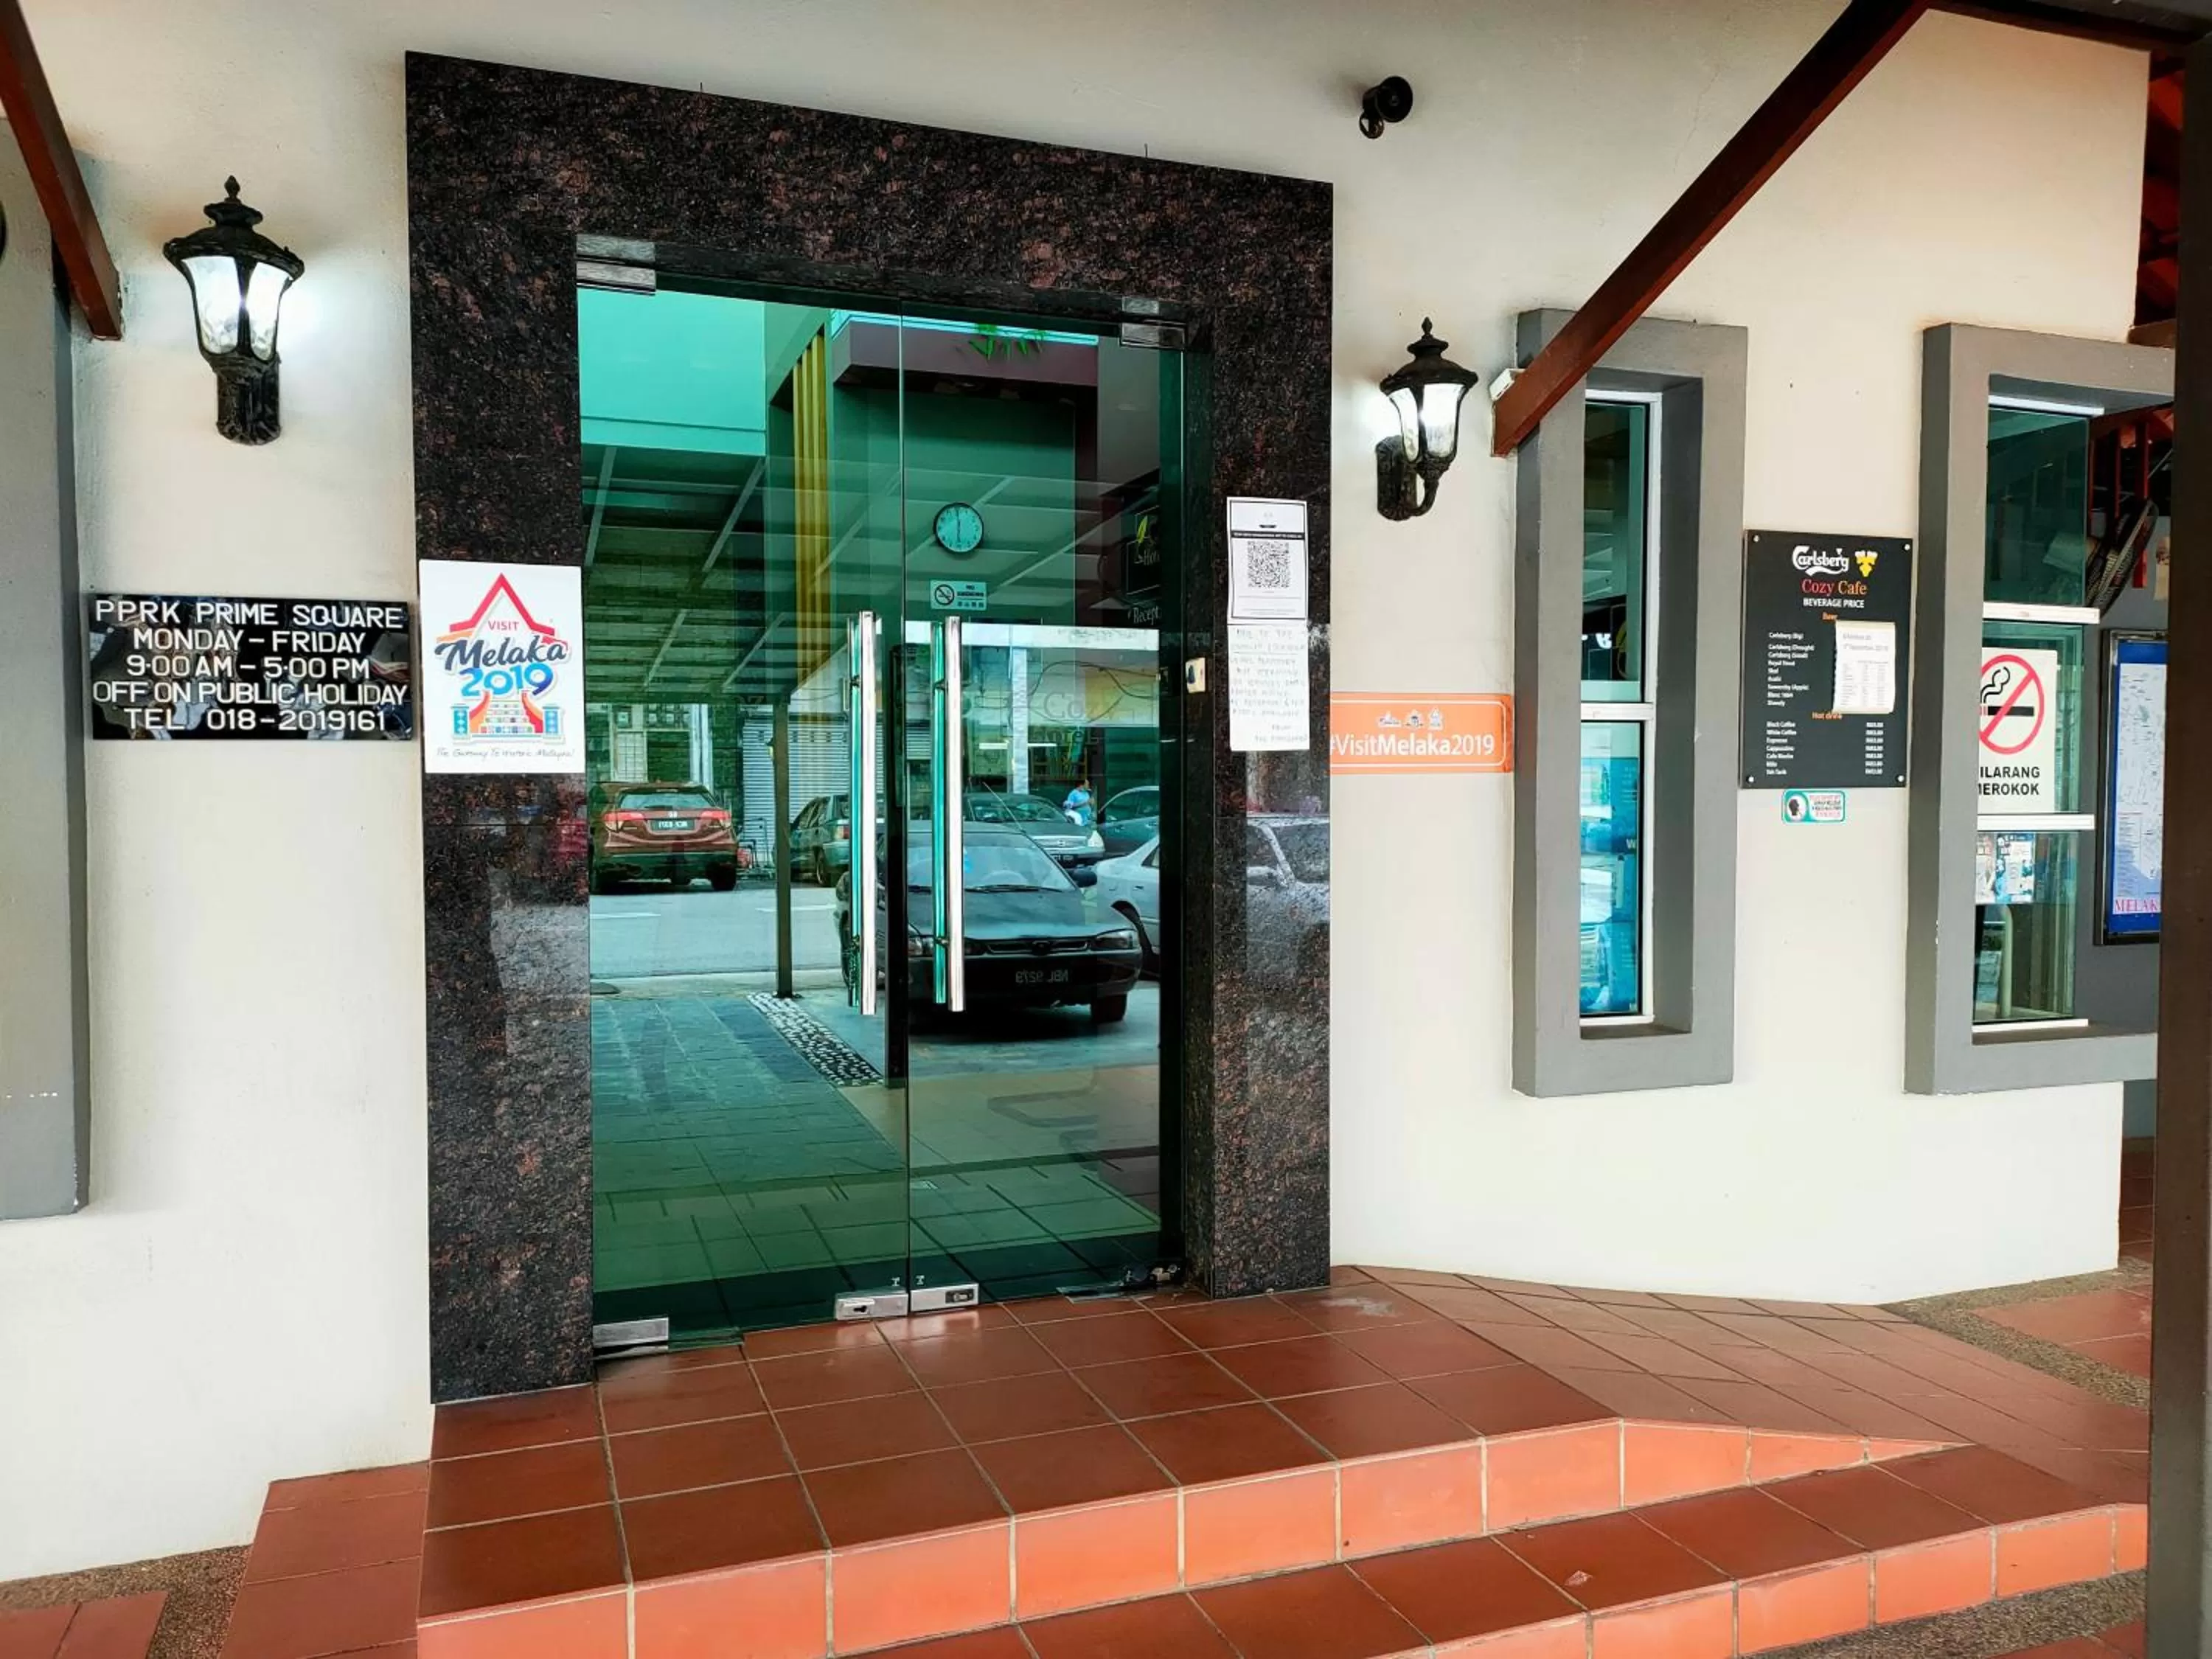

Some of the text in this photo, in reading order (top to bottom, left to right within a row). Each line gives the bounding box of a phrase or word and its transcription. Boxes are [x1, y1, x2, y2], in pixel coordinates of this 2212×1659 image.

[1792, 546, 1849, 574] Carlsberg
[1801, 579, 1867, 597] Cozy Cafe
[95, 600, 403, 629] PPRK PRIME SQUARE
[1803, 597, 1864, 608] BEVERAGE PRICE
[487, 620, 519, 630] VISIT
[133, 628, 244, 651] MONDAY
[272, 630, 366, 653] FRIDAY
[434, 635, 568, 671] Melaka
[195, 657, 233, 678] AM
[333, 658, 369, 679] PM
[459, 662, 554, 697] 2019
[93, 681, 408, 706] OFF ON PUBLIC HOLIDAY
[124, 708, 385, 731] TEL 018-2019161
[1812, 712, 1824, 720] Hot
